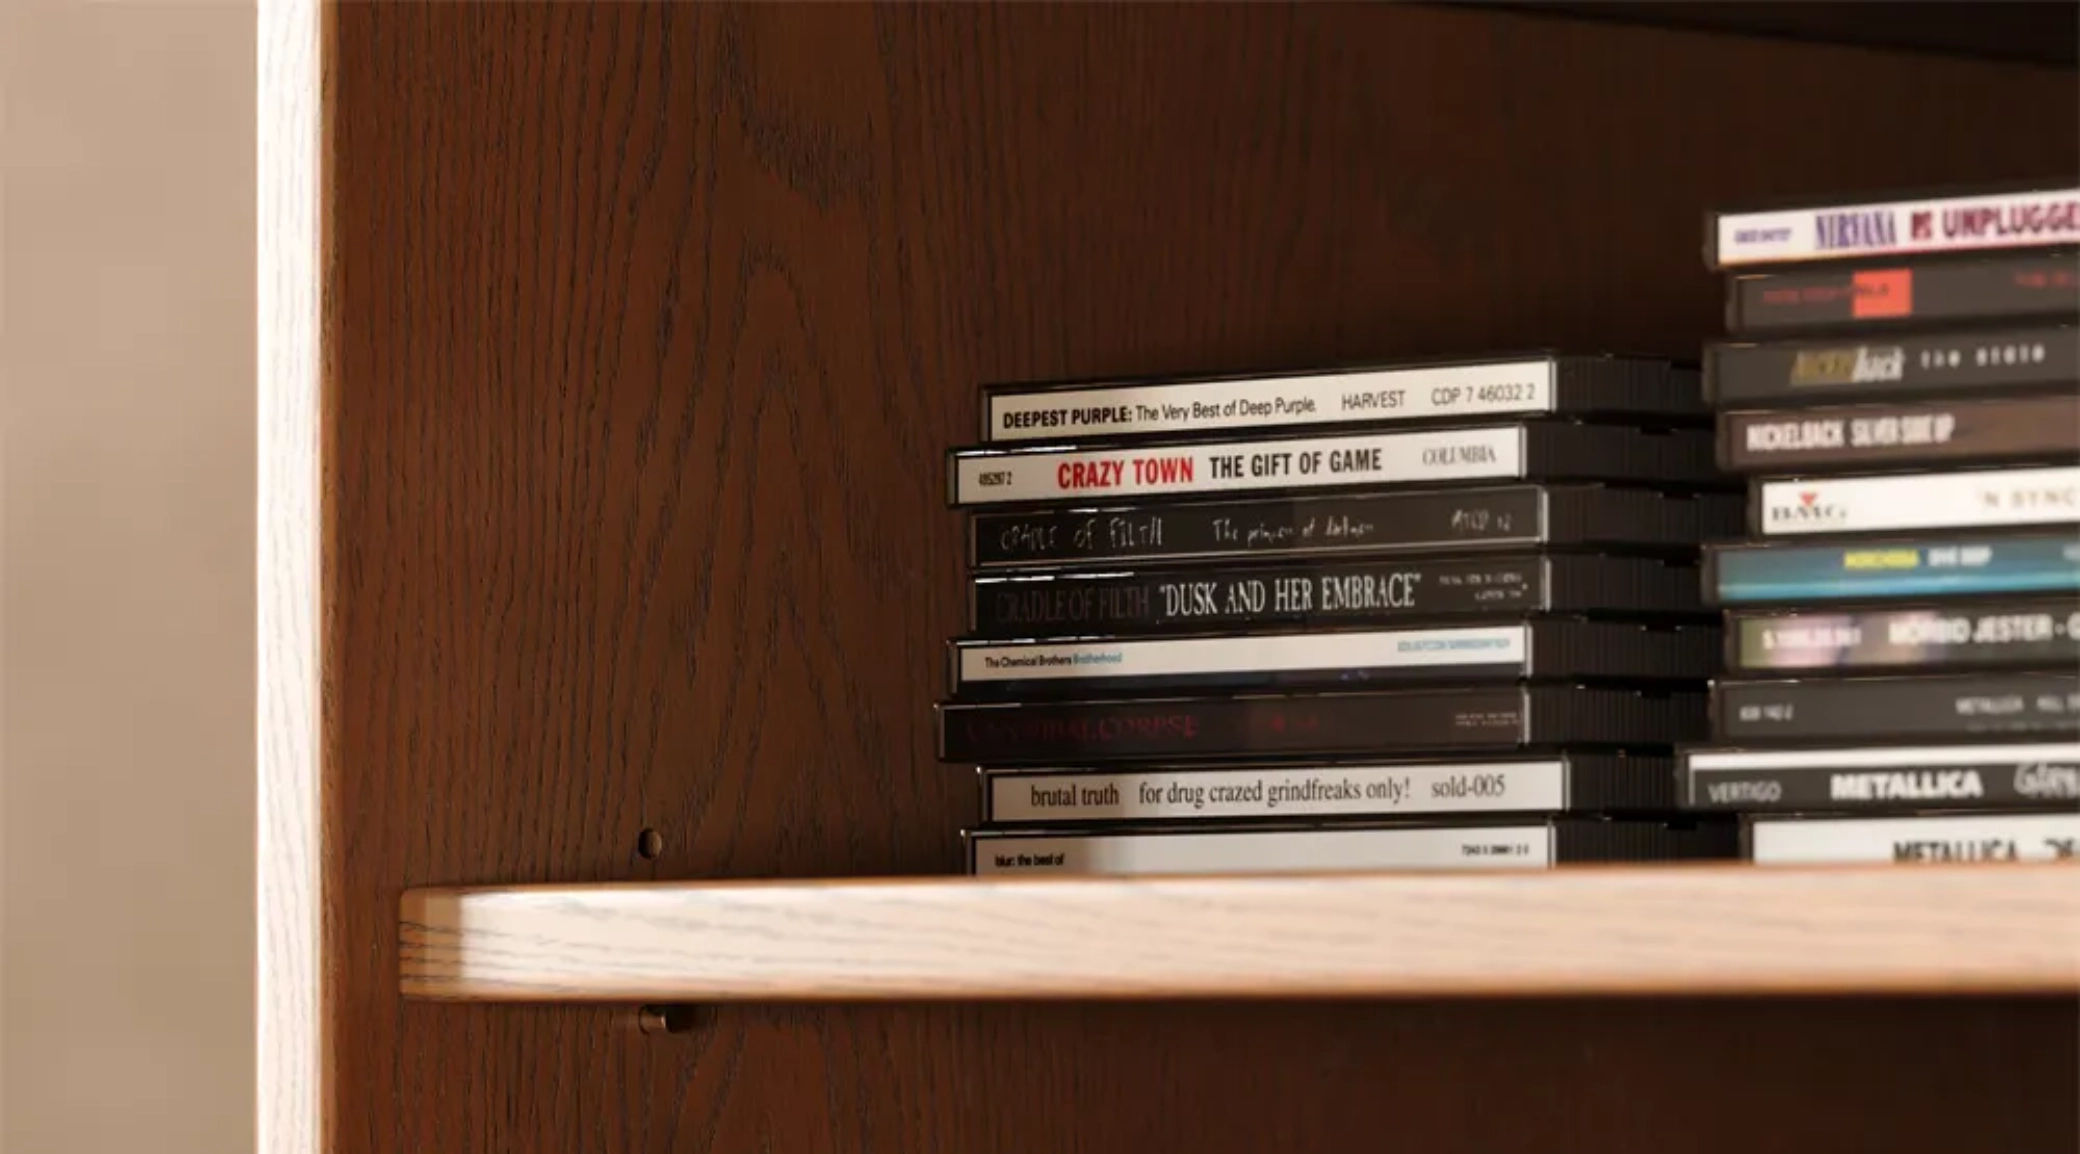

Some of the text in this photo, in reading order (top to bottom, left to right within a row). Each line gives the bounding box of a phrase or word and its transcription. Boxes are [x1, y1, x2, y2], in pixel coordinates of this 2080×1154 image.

[1815, 210, 1898, 249] NIRVANA
[1003, 409, 1067, 429] DEEPEST
[1071, 406, 1132, 426] PURPLE:
[1136, 403, 1160, 422] The
[1163, 402, 1190, 423] Very
[1192, 400, 1221, 419] Best
[1225, 400, 1238, 417] of
[1239, 398, 1273, 419] Deep
[1341, 390, 1406, 411] HARVEST
[1431, 387, 1462, 406] CDP
[1465, 387, 1474, 404] 7
[1477, 384, 1524, 403] 46032
[1526, 383, 1536, 401] 2
[1057, 459, 1125, 489] CRAZY
[1133, 457, 1194, 485] TOWN
[1209, 455, 1244, 479] THE
[1252, 453, 1292, 477] GIFT
[1299, 450, 1322, 475] OF
[1330, 448, 1382, 473] GAME
[1422, 443, 1497, 467] COLUMBIA
[1212, 518, 1238, 543] The
[997, 573, 1422, 621] CRADLE OF FILTH "DUSK AND HER EMBRACE"
[985, 657, 999, 670] The
[1001, 655, 1037, 669] Chemical
[1039, 653, 1072, 667] Brothers
[1031, 773, 1506, 809] brutal truth for drug crazed grindfreaks only! sold-005
[1708, 781, 1782, 803] VERTIGO
[1830, 770, 1984, 801] METALLICA
[1017, 854, 1032, 867] the
[1033, 853, 1052, 866] best
[1054, 852, 1065, 865] of
